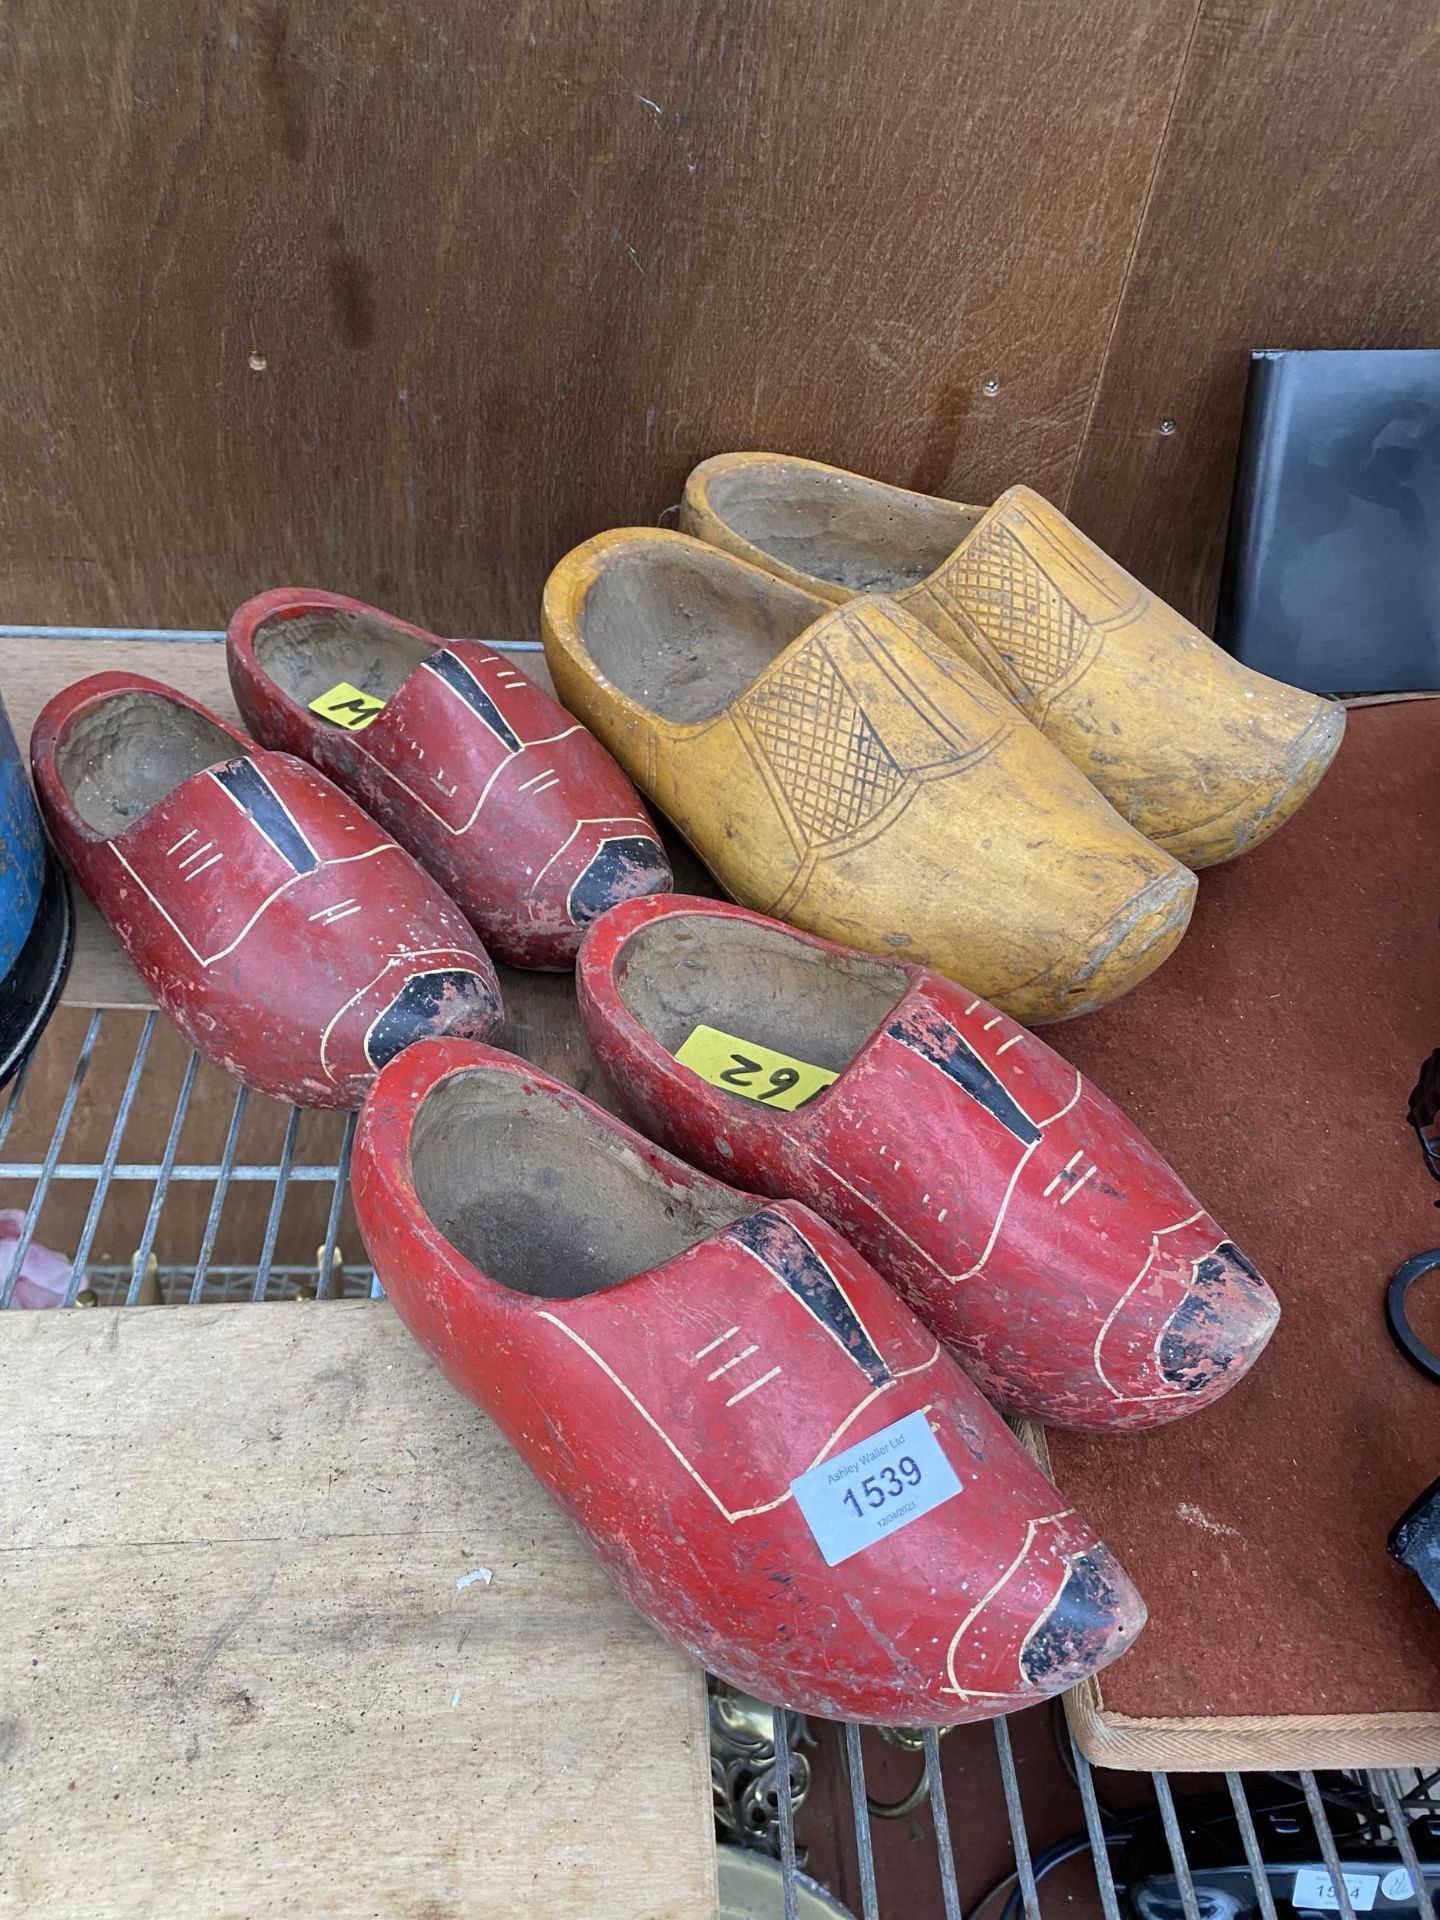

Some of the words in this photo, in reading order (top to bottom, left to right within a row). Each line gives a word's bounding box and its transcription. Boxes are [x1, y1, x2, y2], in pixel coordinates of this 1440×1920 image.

[720, 1054, 829, 1109] 62
[827, 1462, 860, 1485] Ashley
[859, 1445, 889, 1466] Waller
[889, 1434, 906, 1449] Ltd
[843, 1456, 922, 1518] 1539
[876, 1501, 917, 1529] 12/04/2023
[1316, 1885, 1360, 1900] 154
